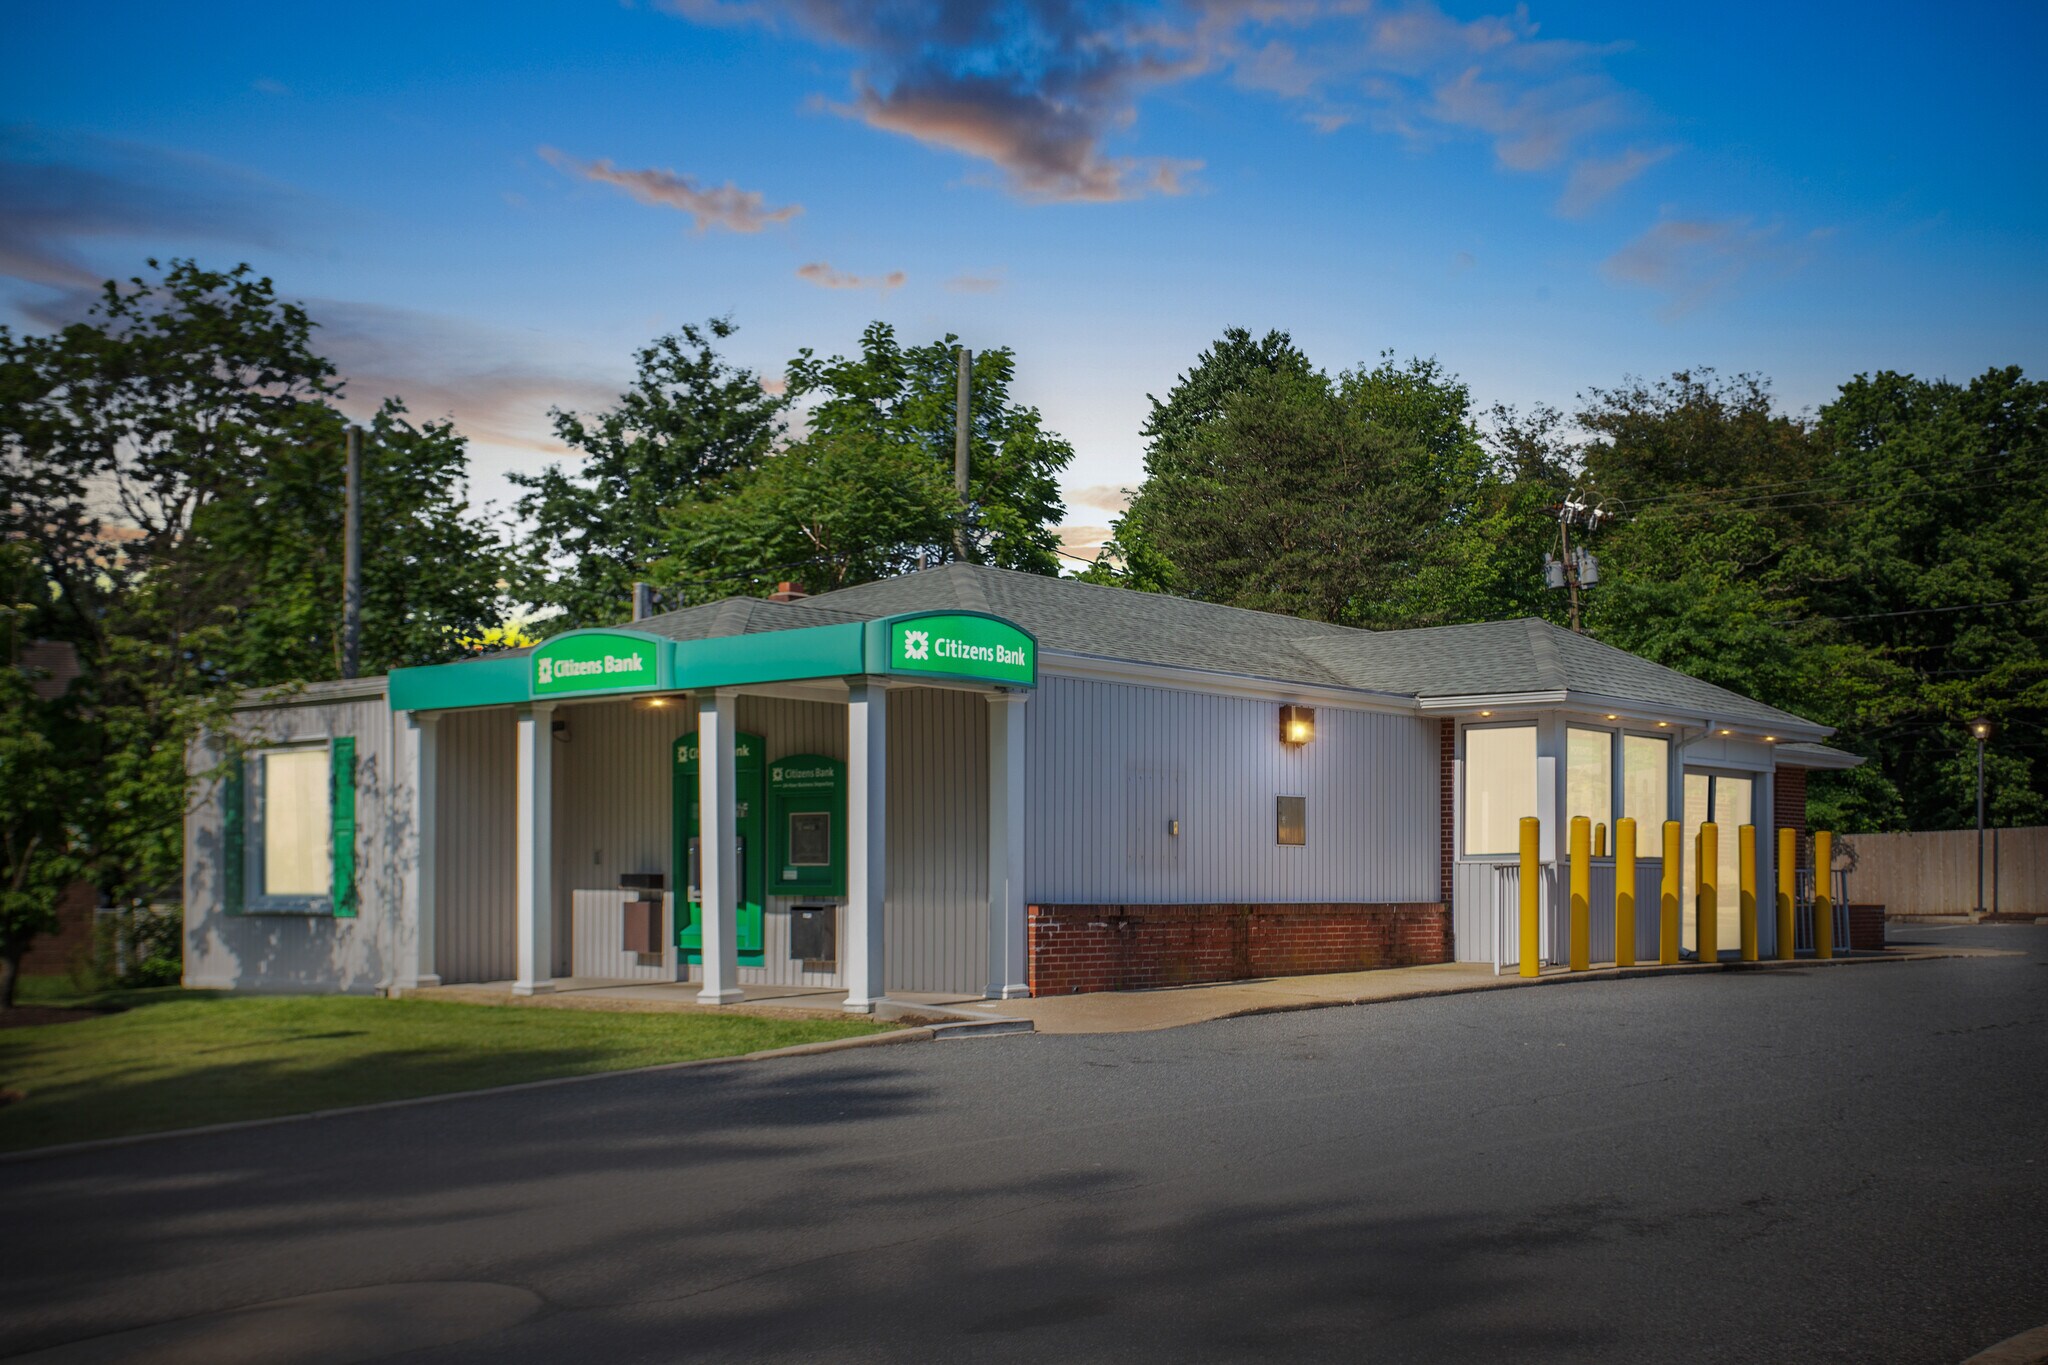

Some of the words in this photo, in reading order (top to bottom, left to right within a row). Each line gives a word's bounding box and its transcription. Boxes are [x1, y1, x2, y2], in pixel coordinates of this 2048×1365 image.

[935, 638, 993, 661] Citizens
[997, 645, 1025, 665] Bank
[554, 660, 603, 678] Citizens
[604, 653, 642, 673] Bank
[736, 744, 750, 757] nk
[785, 768, 814, 779] Citizens
[815, 767, 834, 778] Bank
